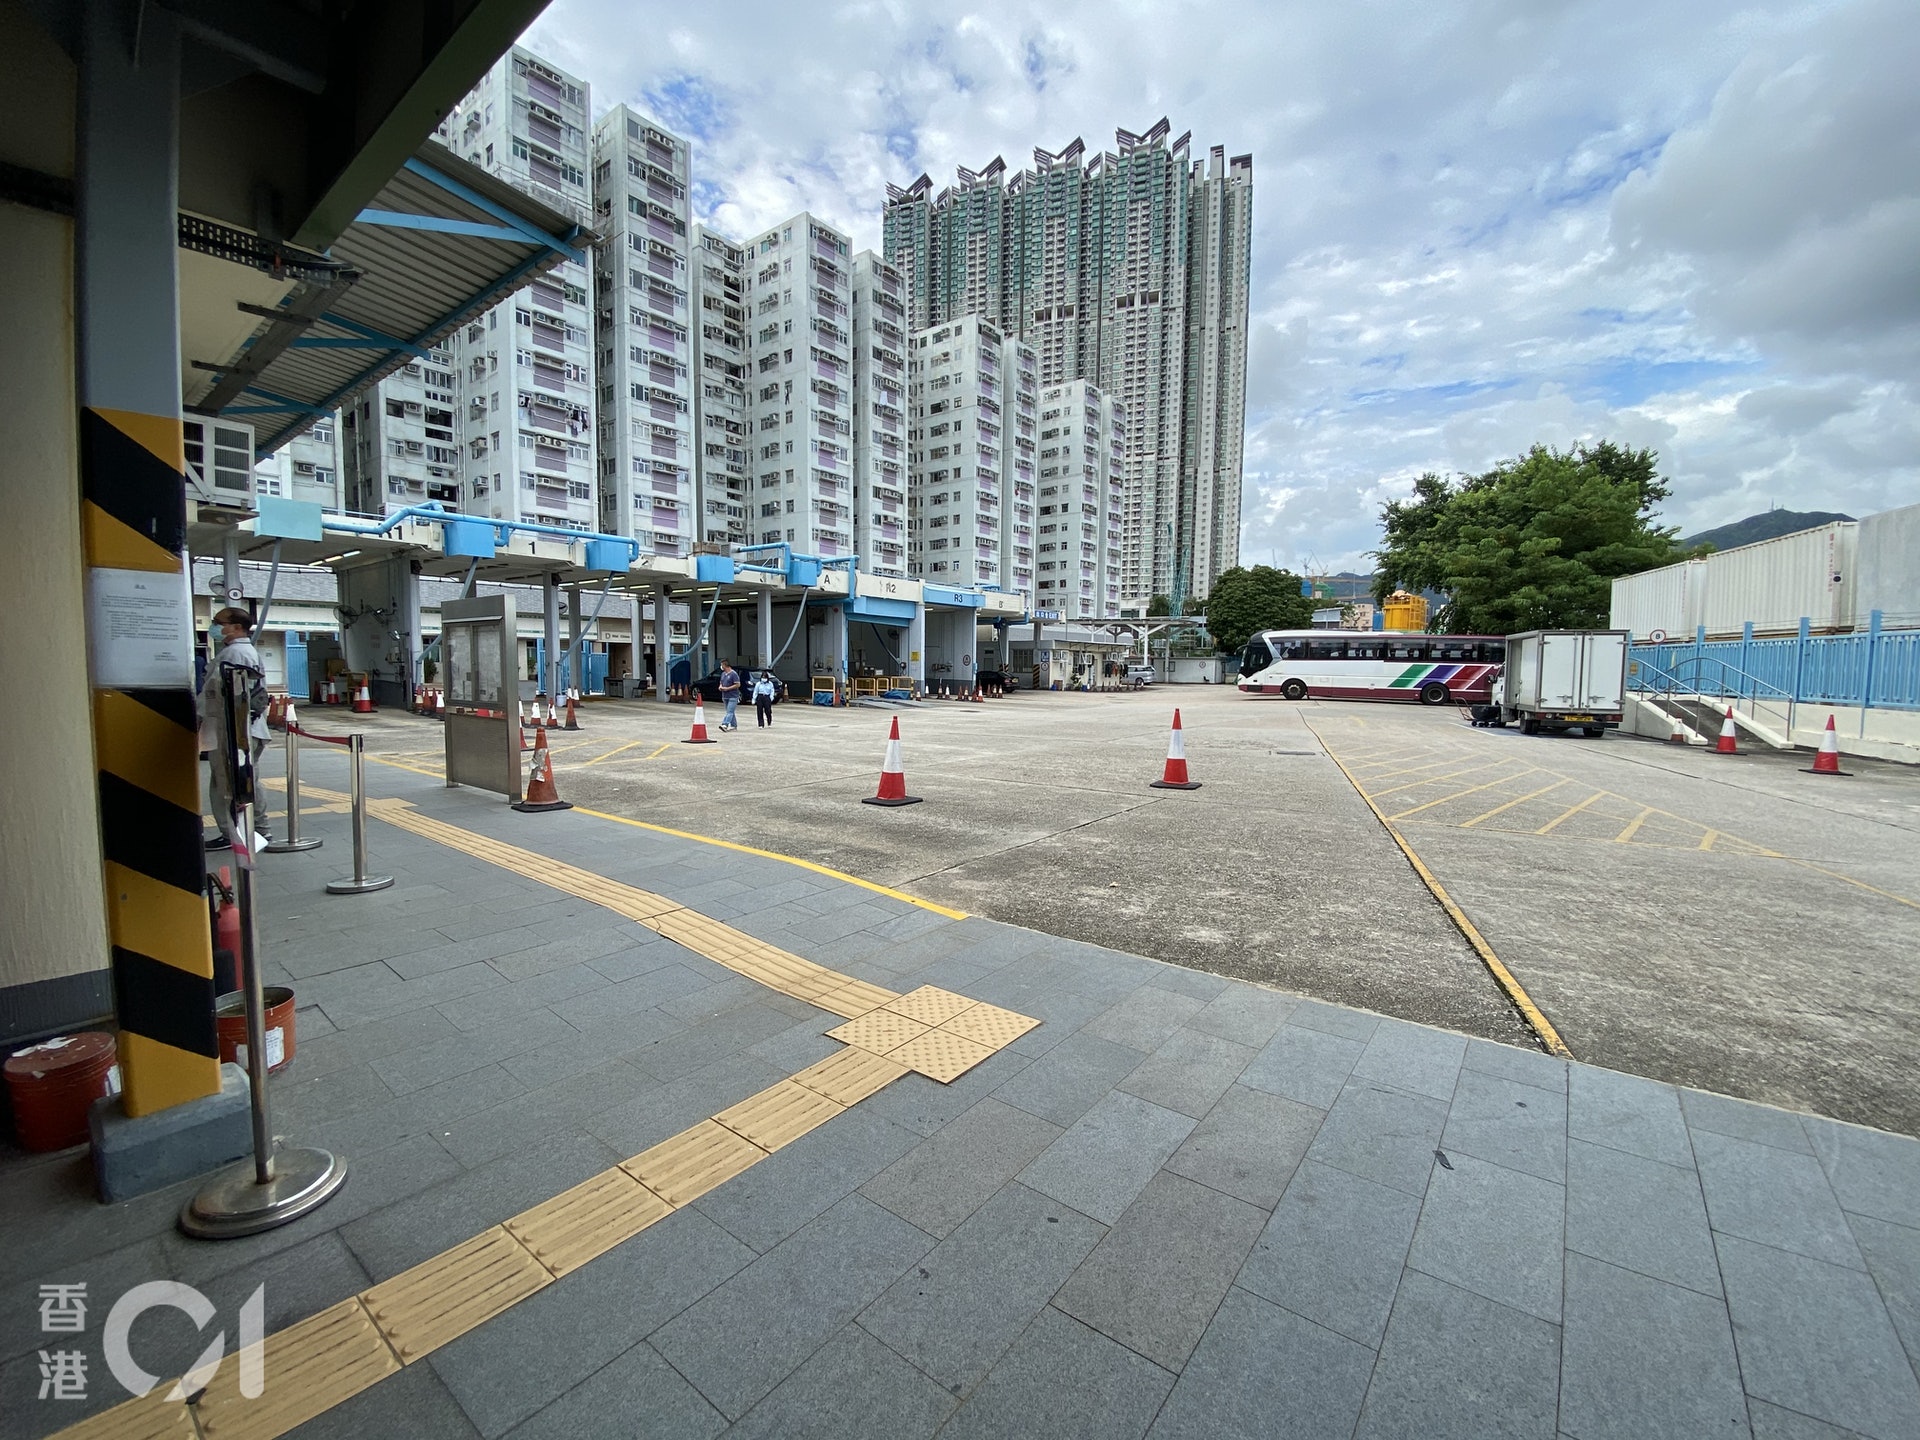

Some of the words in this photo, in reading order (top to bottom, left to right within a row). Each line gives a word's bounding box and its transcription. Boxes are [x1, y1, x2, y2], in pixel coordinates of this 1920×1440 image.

[528, 541, 536, 555] 1
[824, 574, 831, 585] A
[954, 593, 963, 603] R3
